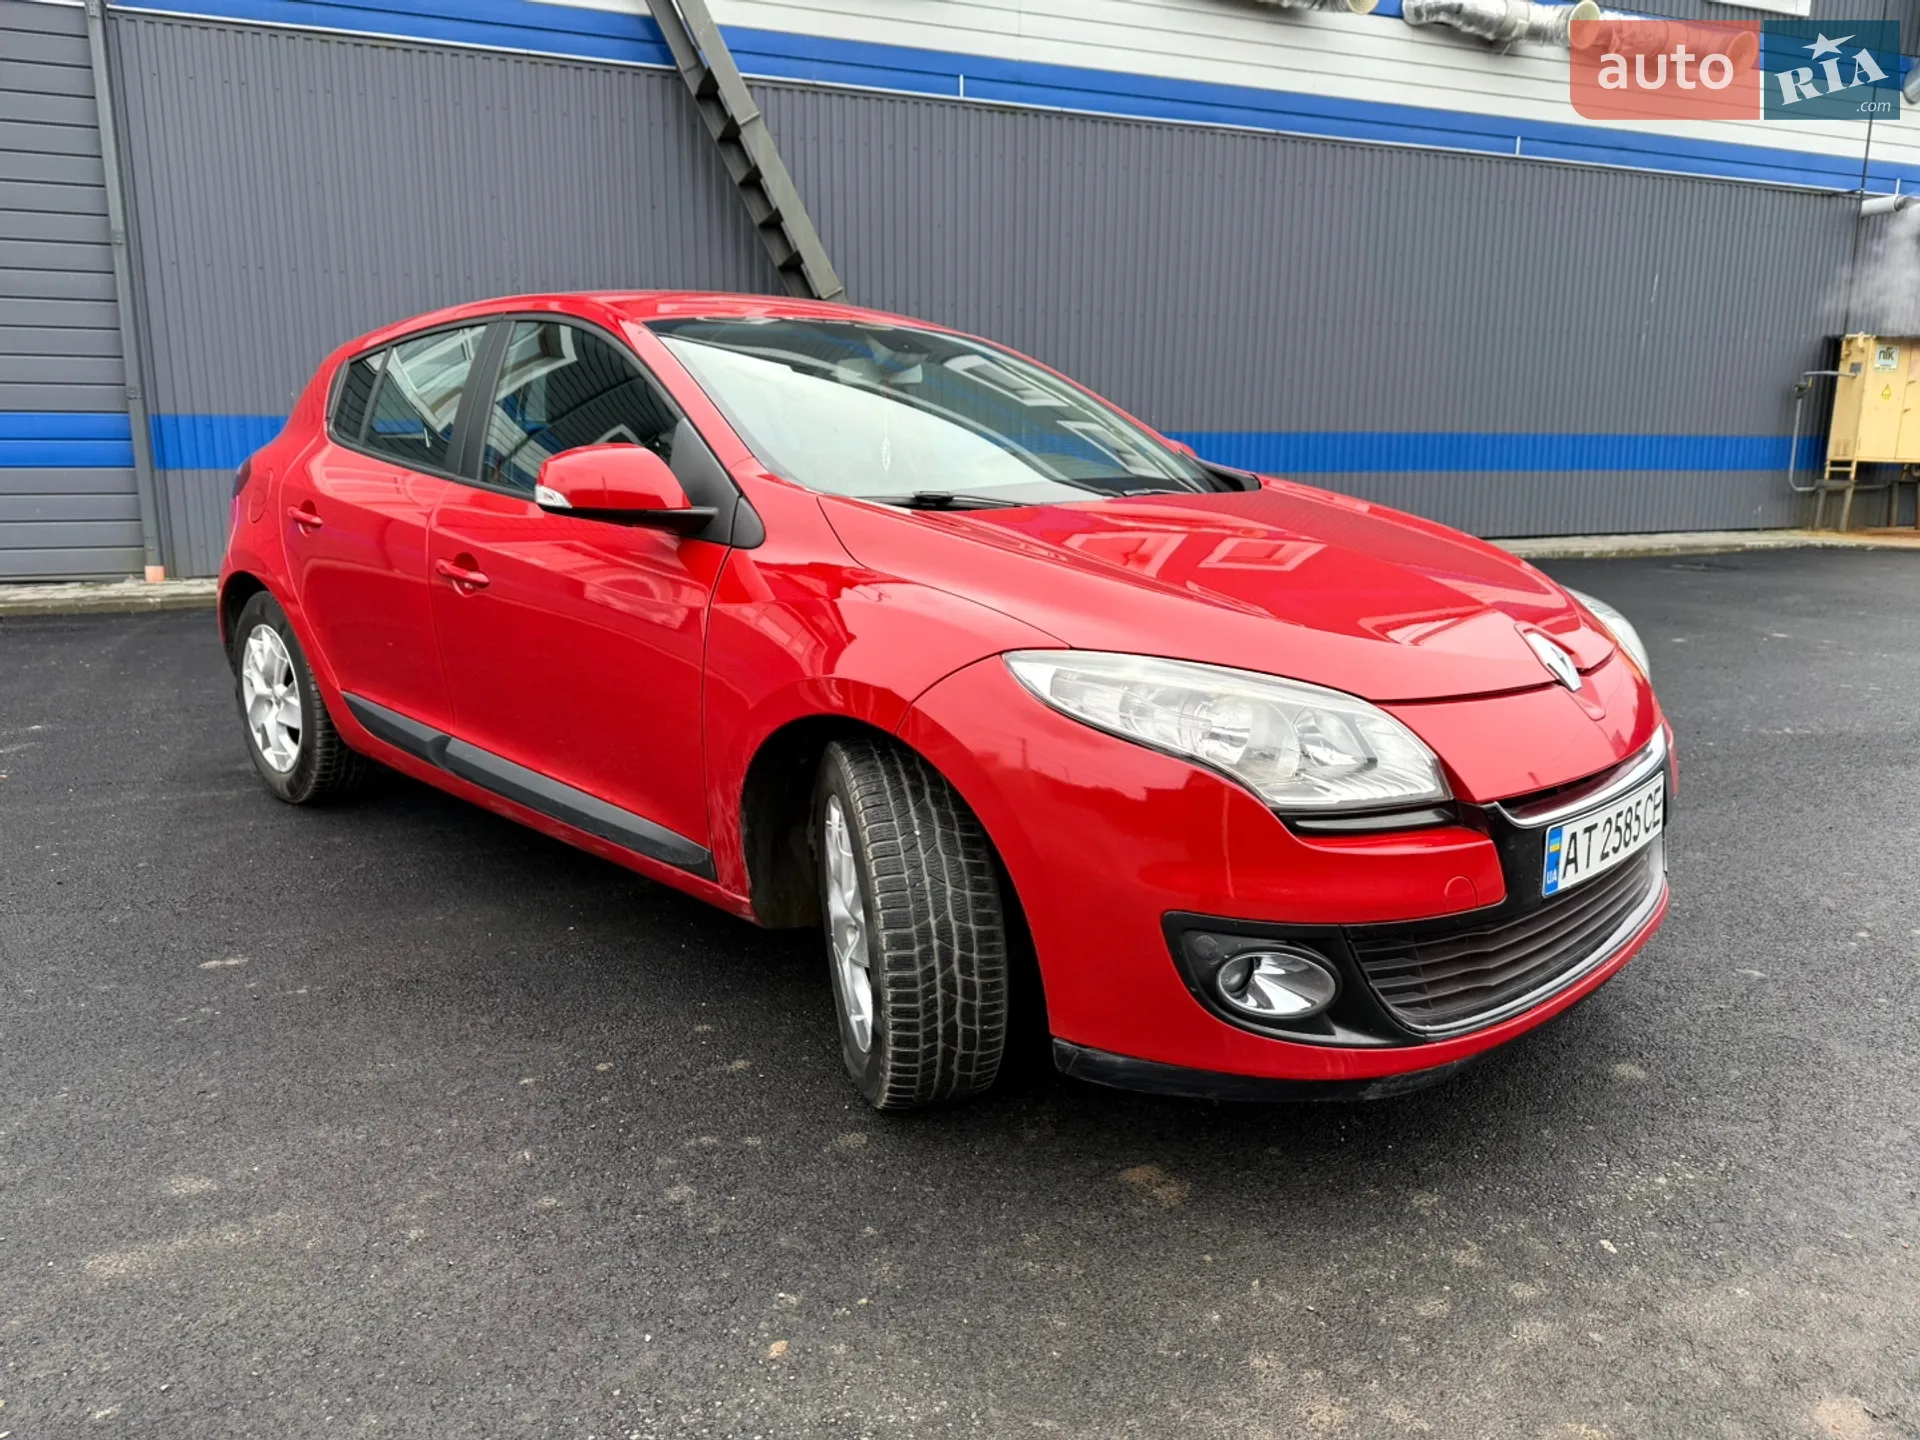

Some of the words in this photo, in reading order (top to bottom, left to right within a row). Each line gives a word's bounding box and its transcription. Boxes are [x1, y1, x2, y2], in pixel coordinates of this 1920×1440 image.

[1562, 823, 1598, 879] AT
[1600, 799, 1642, 861] 2585
[1643, 785, 1662, 834] CE
[1546, 868, 1558, 884] UA
